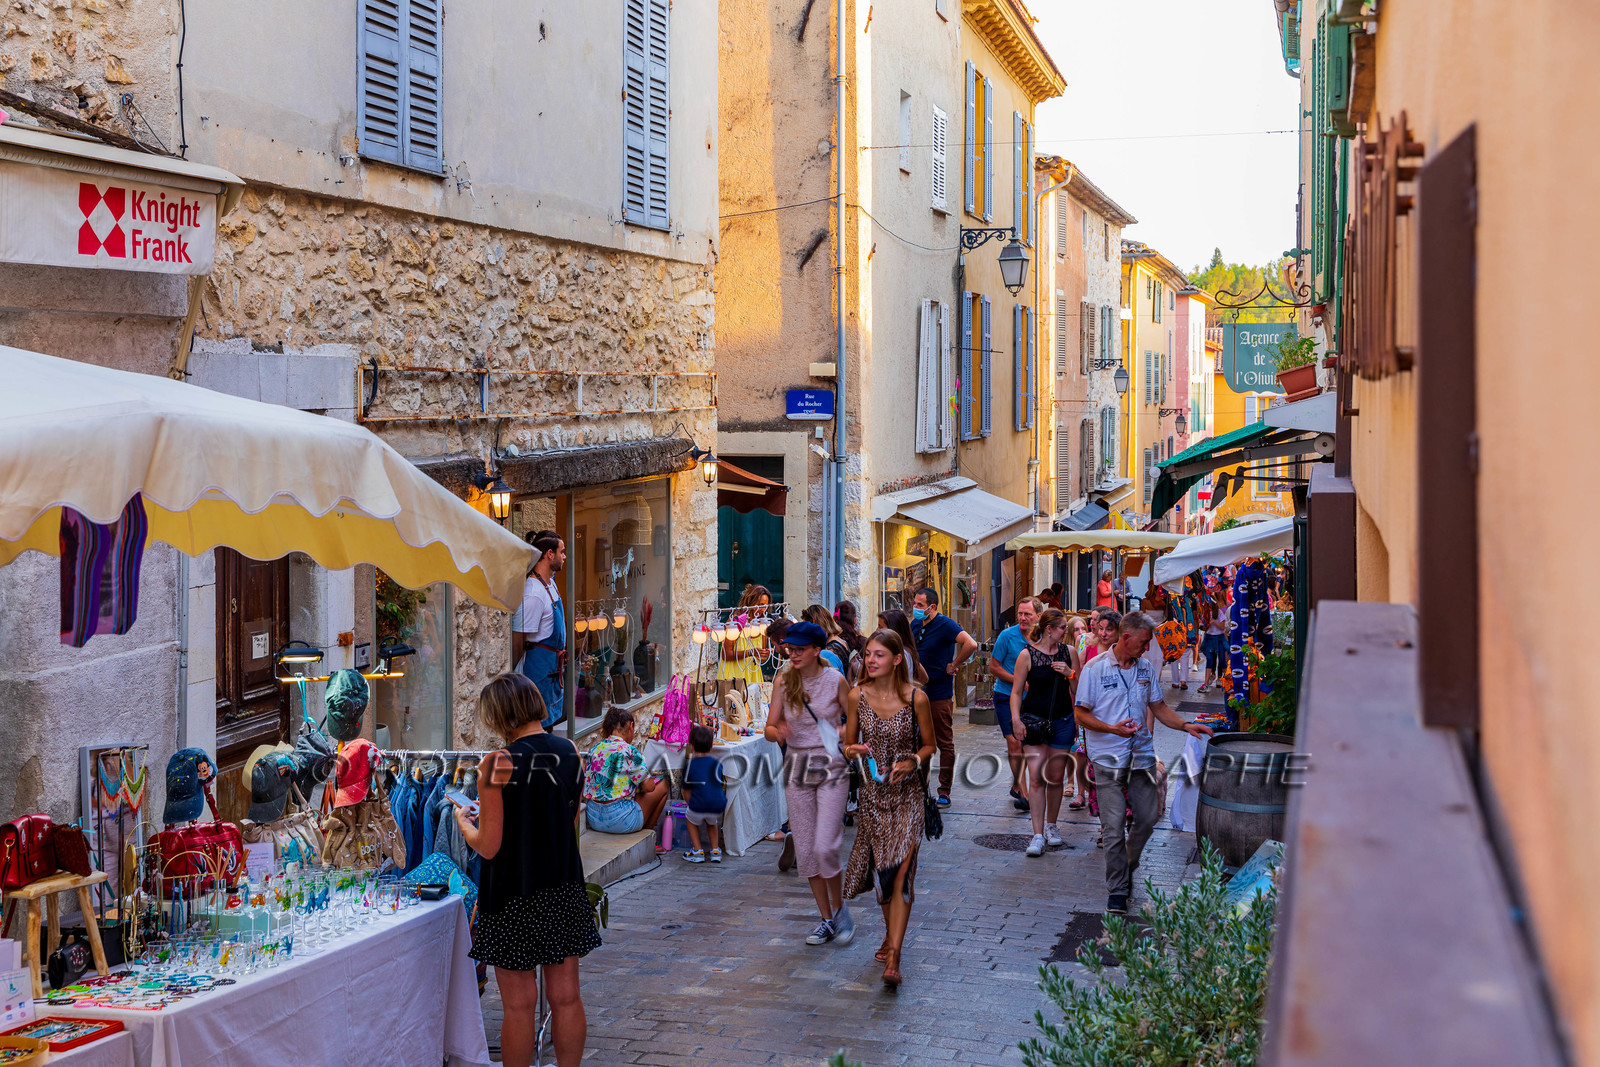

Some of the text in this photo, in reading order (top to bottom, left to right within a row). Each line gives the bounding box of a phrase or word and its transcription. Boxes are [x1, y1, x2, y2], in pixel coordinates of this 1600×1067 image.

[132, 190, 200, 233] Knight
[132, 229, 192, 263] Frank
[1240, 331, 1279, 347] Agence
[1254, 352, 1265, 365] de
[1236, 371, 1282, 385] l'Olivi
[628, 563, 646, 580] WINE
